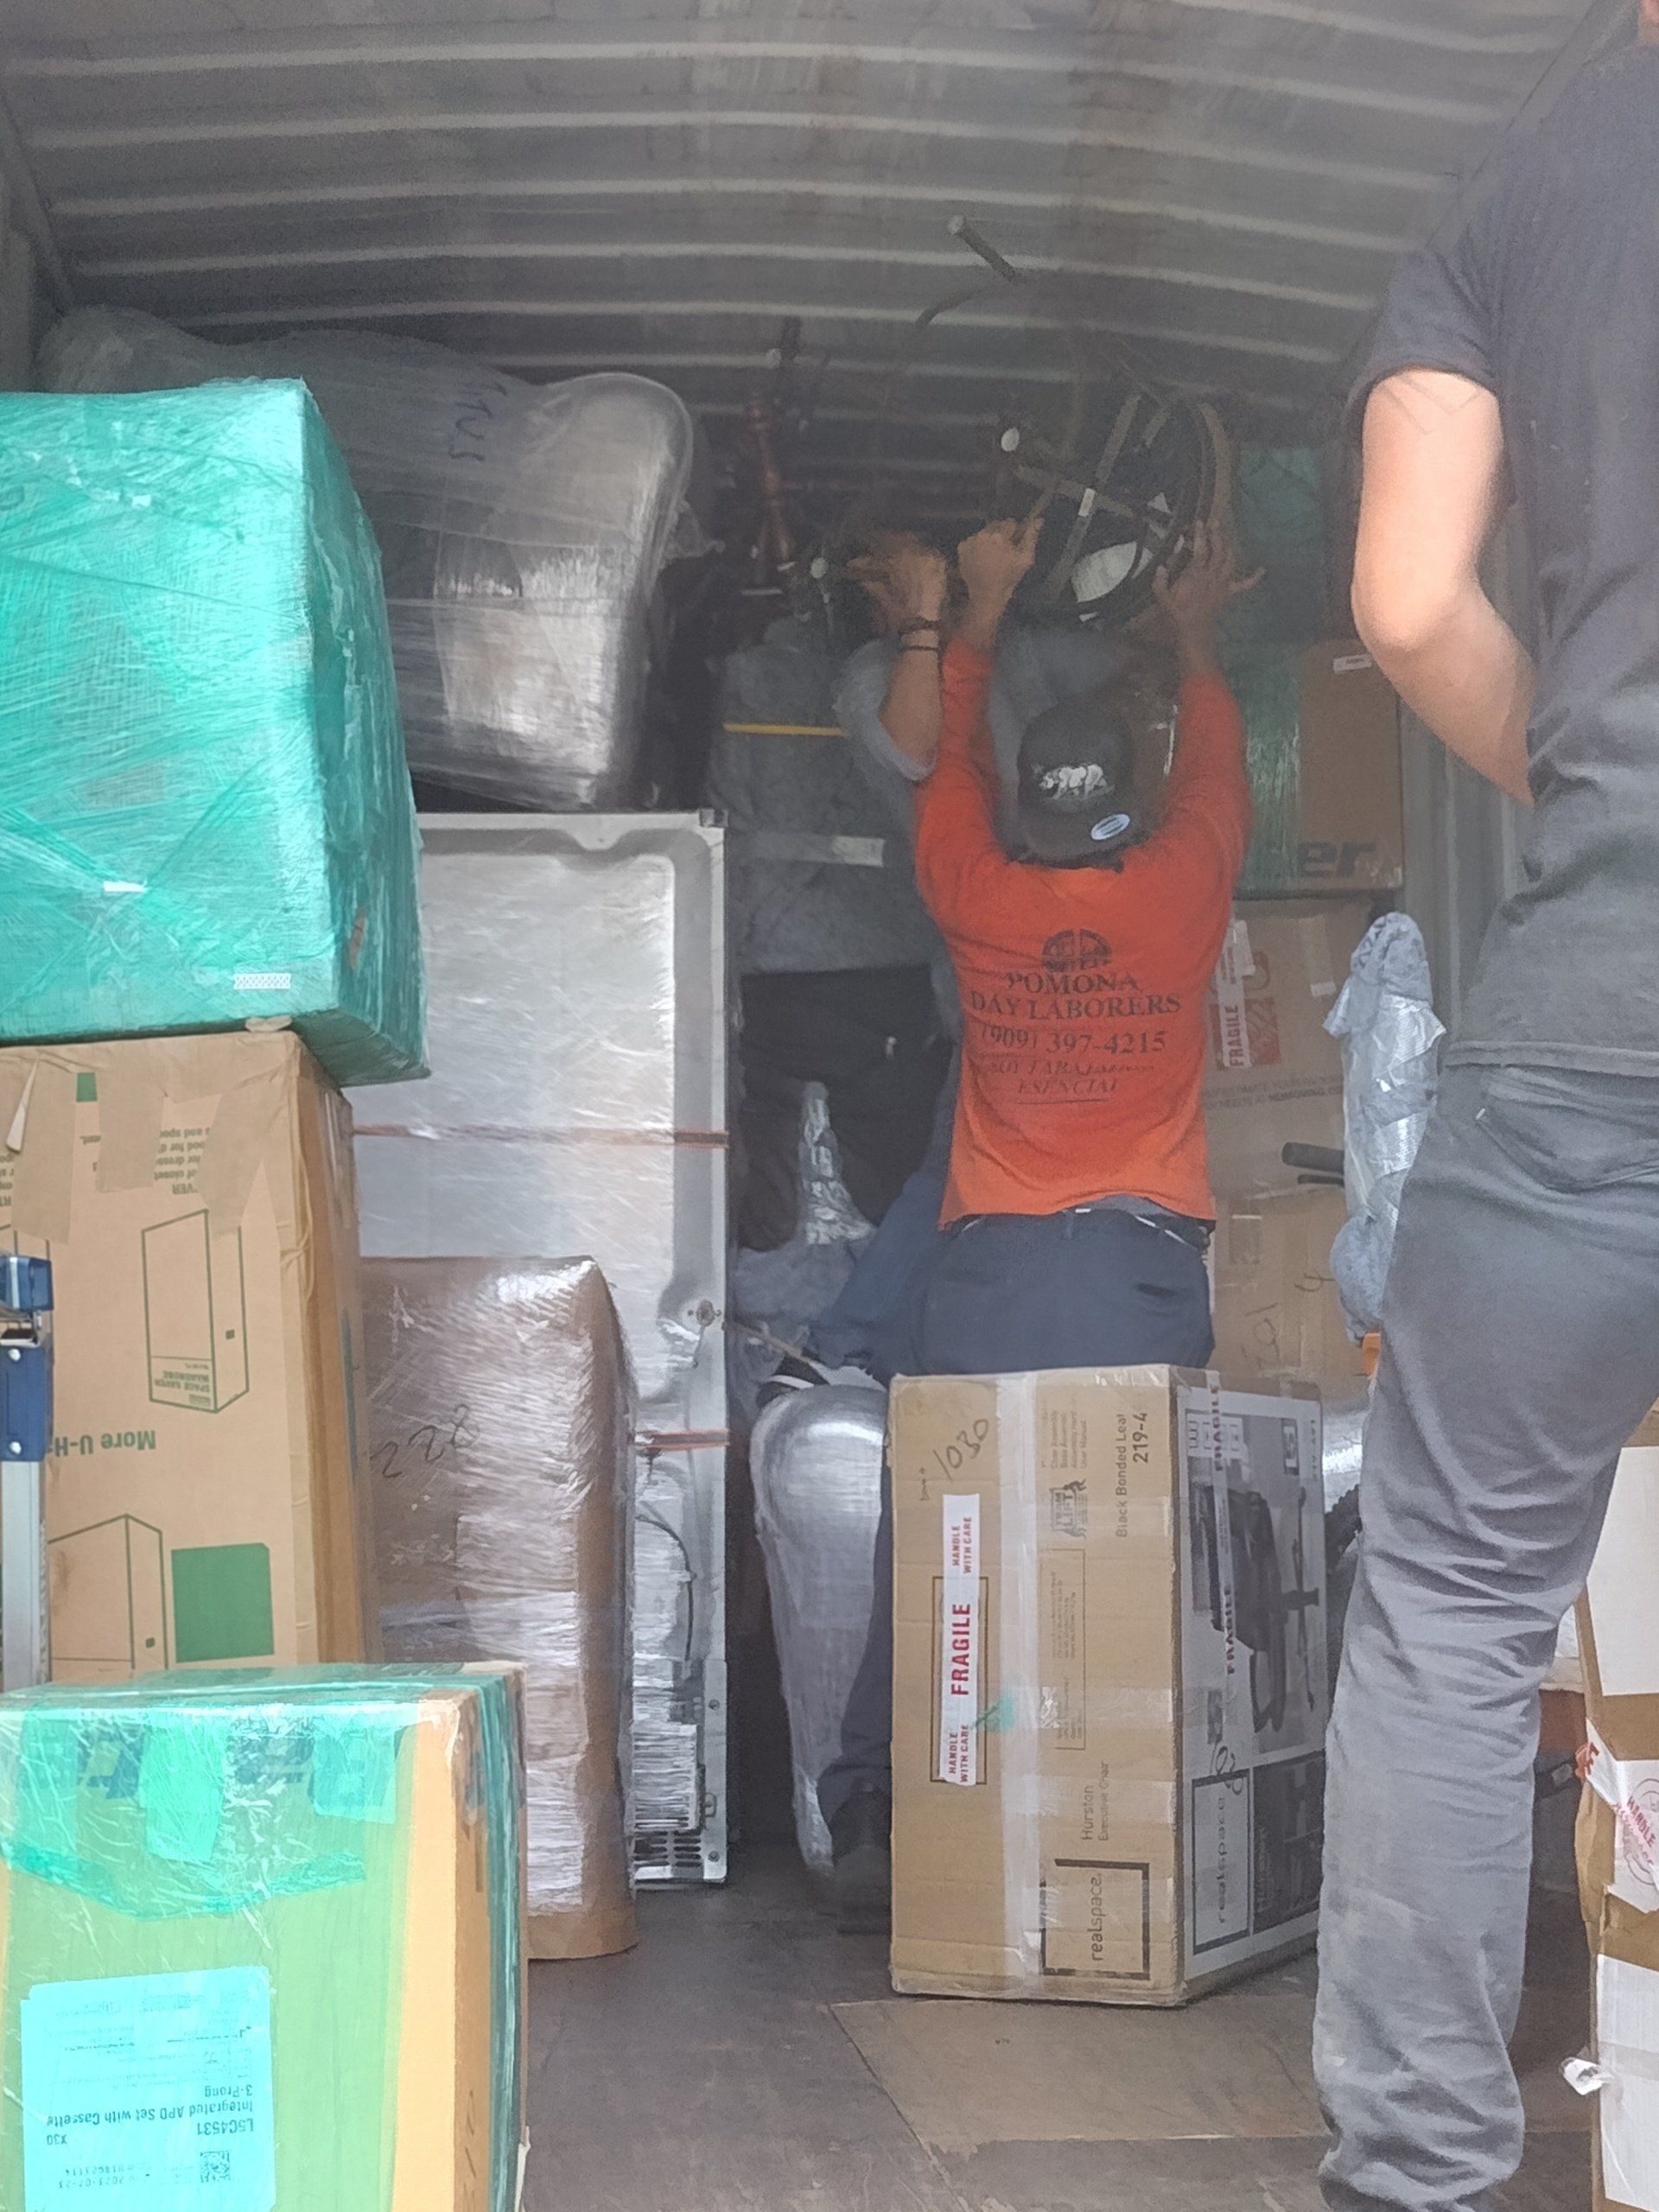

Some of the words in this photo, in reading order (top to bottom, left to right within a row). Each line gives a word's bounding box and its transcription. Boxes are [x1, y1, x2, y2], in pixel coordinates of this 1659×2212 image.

[1005, 972, 1141, 994] POMONA
[971, 991, 1022, 1016] DAY
[1028, 993, 1181, 1020] LABORERS
[1045, 1031, 1166, 1054] 397-4215
[1224, 1005, 1245, 1067] FRAGILE
[172, 1183, 199, 1195] VER
[100, 1430, 156, 1451] More
[1211, 1384, 1224, 1471] FRAGILE
[1115, 1446, 1127, 1496] Bonded
[963, 1516, 972, 1545] CARE
[1115, 1501, 1128, 1538] Black
[951, 1525, 961, 1567] HANDLE
[963, 1547, 972, 1574] WITH
[1224, 1585, 1236, 1675] FRAGILE
[951, 1603, 970, 1696] FRAGILE
[960, 1724, 969, 1752] CARE
[948, 1732, 958, 1775] HANDLE
[959, 1755, 969, 1783] WITH
[1082, 1785, 1094, 1840] Hurston
[1627, 1796, 1656, 1847] HANDLE
[204, 2084, 253, 2098] 3-Prong
[47, 2113, 100, 2126] Cassette
[105, 2110, 131, 2123] with
[136, 2108, 156, 2121] Set
[160, 2106, 185, 2120] APD
[188, 2101, 253, 2118] Integrated
[196, 2118, 254, 2136] L5C4531
